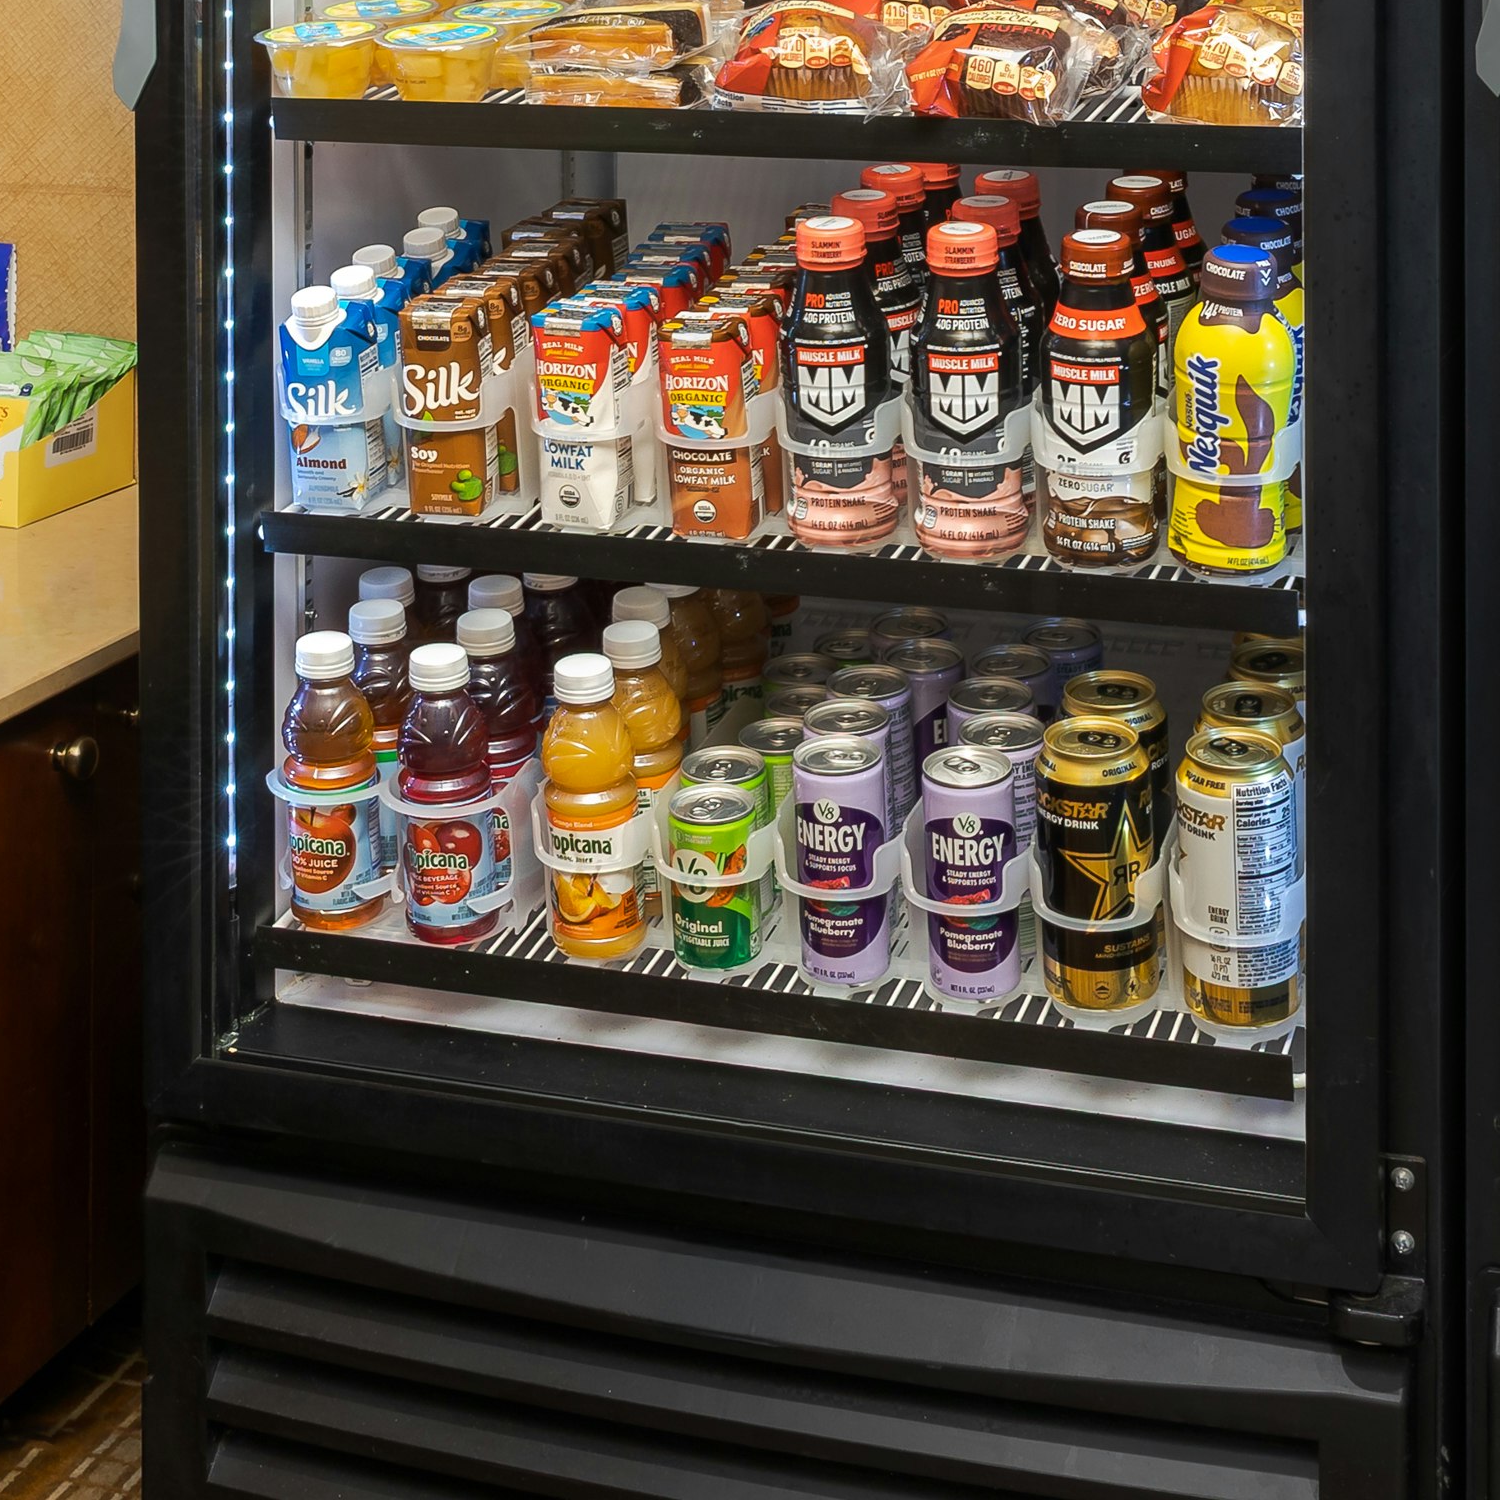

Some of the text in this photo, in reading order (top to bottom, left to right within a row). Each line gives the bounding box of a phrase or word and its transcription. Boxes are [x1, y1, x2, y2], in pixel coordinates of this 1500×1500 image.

[982, 22, 1056, 40] MUFFIN
[968, 56, 994, 75] 460
[1205, 262, 1246, 281] CHOCOLATE
[805, 292, 825, 310] PRO
[802, 310, 856, 325] 40G PROTEIN
[1053, 314, 1077, 331] ZERO
[416, 334, 450, 343] CHOCOLATE
[798, 346, 863, 364] MUSCLE MILK
[403, 361, 480, 418] Silk
[665, 372, 730, 393] HORIZON
[670, 390, 725, 405] ORGANIC
[1185, 351, 1222, 483] Nesquik
[295, 456, 347, 472] Almond
[410, 446, 438, 464] Soy
[672, 449, 733, 464] CHOCOLATE
[673, 473, 737, 485] LOWFAT MILK
[1101, 761, 1137, 778] ORIGINAL
[1235, 778, 1288, 797] Nutrition Facts
[956, 815, 977, 833] V8
[1235, 815, 1271, 829] Calories
[931, 834, 1004, 867] ENERGY
[674, 914, 724, 935] Original
[803, 908, 865, 930] Pomegranate
[809, 920, 856, 939] Blueberry
